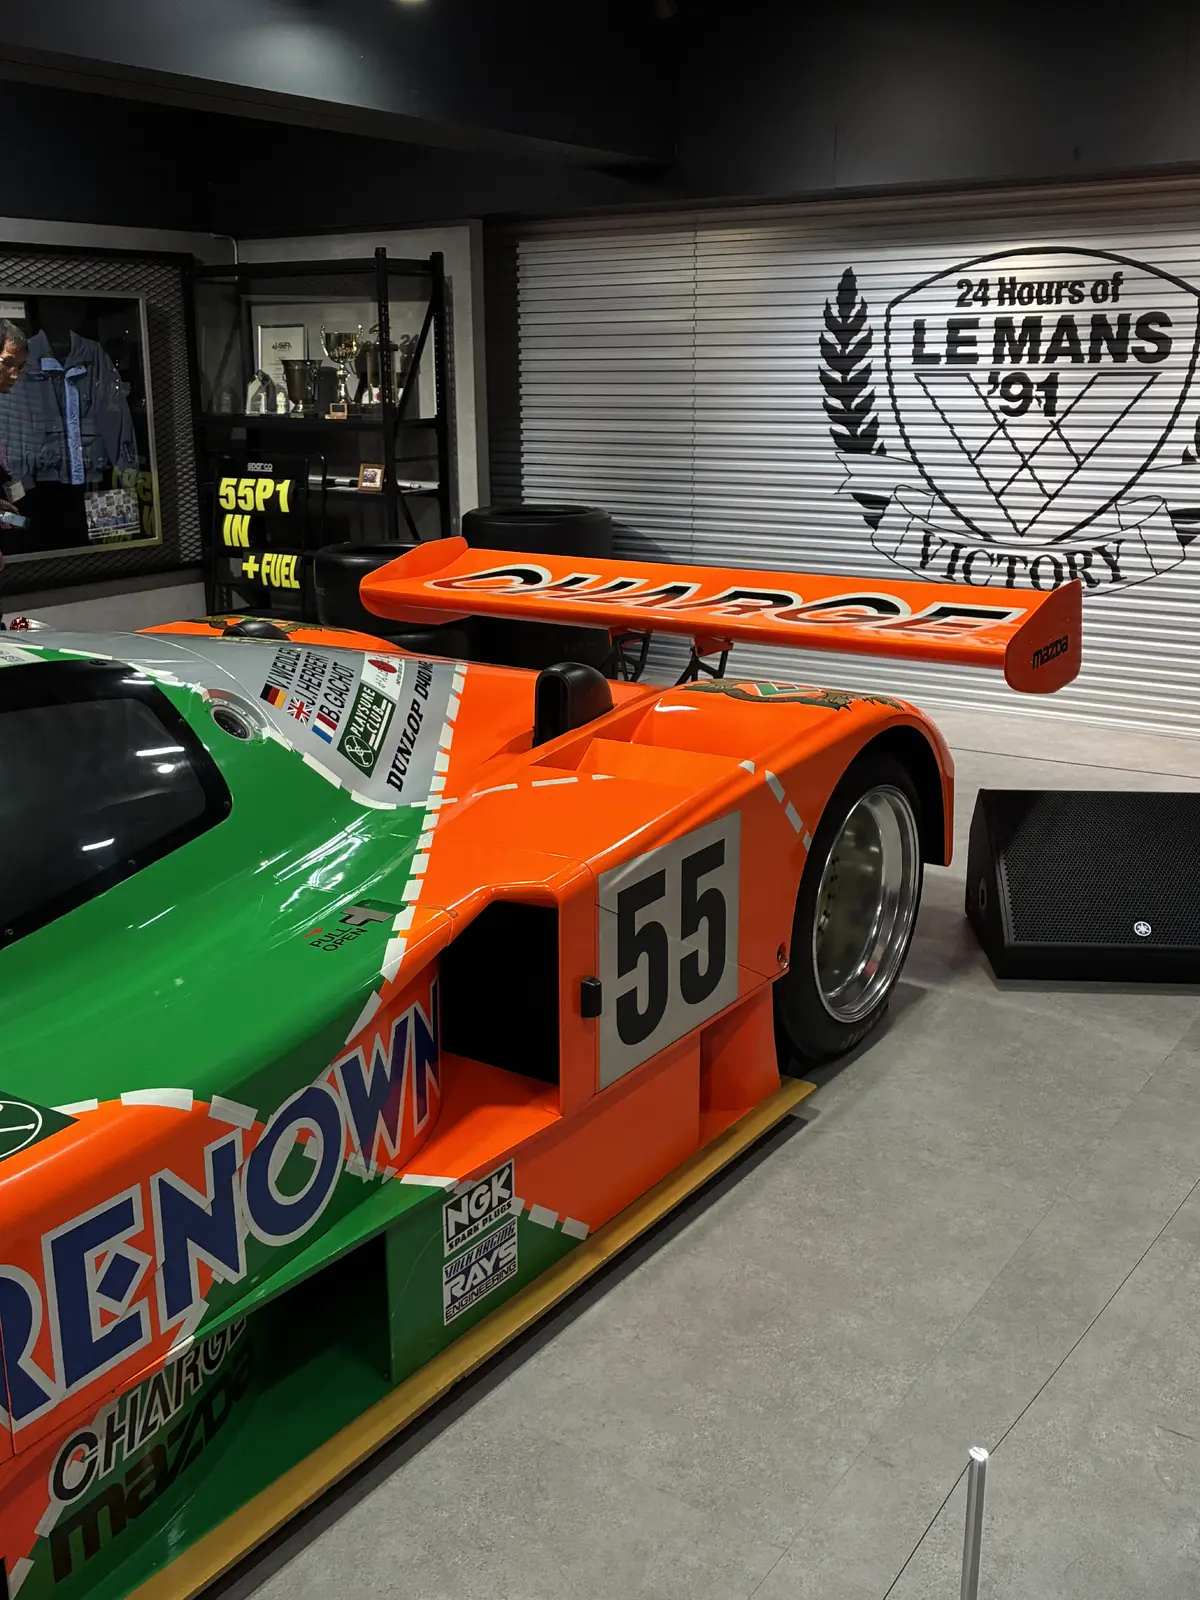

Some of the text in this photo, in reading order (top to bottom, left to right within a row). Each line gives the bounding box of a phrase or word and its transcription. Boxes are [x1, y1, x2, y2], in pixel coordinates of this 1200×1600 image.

[955, 272, 1123, 307] 24 Hours of
[912, 312, 1174, 364] LE MANS
[987, 371, 1060, 417] '91
[247, 462, 273, 471] sparco
[219, 477, 291, 513] 55P1
[223, 514, 251, 548] IN
[261, 553, 300, 589] FUEL
[918, 528, 1127, 592] VICTORY
[424, 563, 1028, 636] CHARGE
[319, 662, 355, 723] B.GACHOT
[350, 687, 376, 737] PLAYSURE
[367, 704, 384, 734] CLUB
[386, 699, 424, 792] DUNLOP
[309, 927, 353, 947] PULL
[323, 928, 368, 951] OPEN
[616, 837, 727, 1046] 55
[447, 1165, 512, 1240] NGK
[449, 1200, 512, 1251] SPARK PLUGS
[444, 1240, 517, 1304] RAYS
[445, 1261, 517, 1319] ENGINEERING
